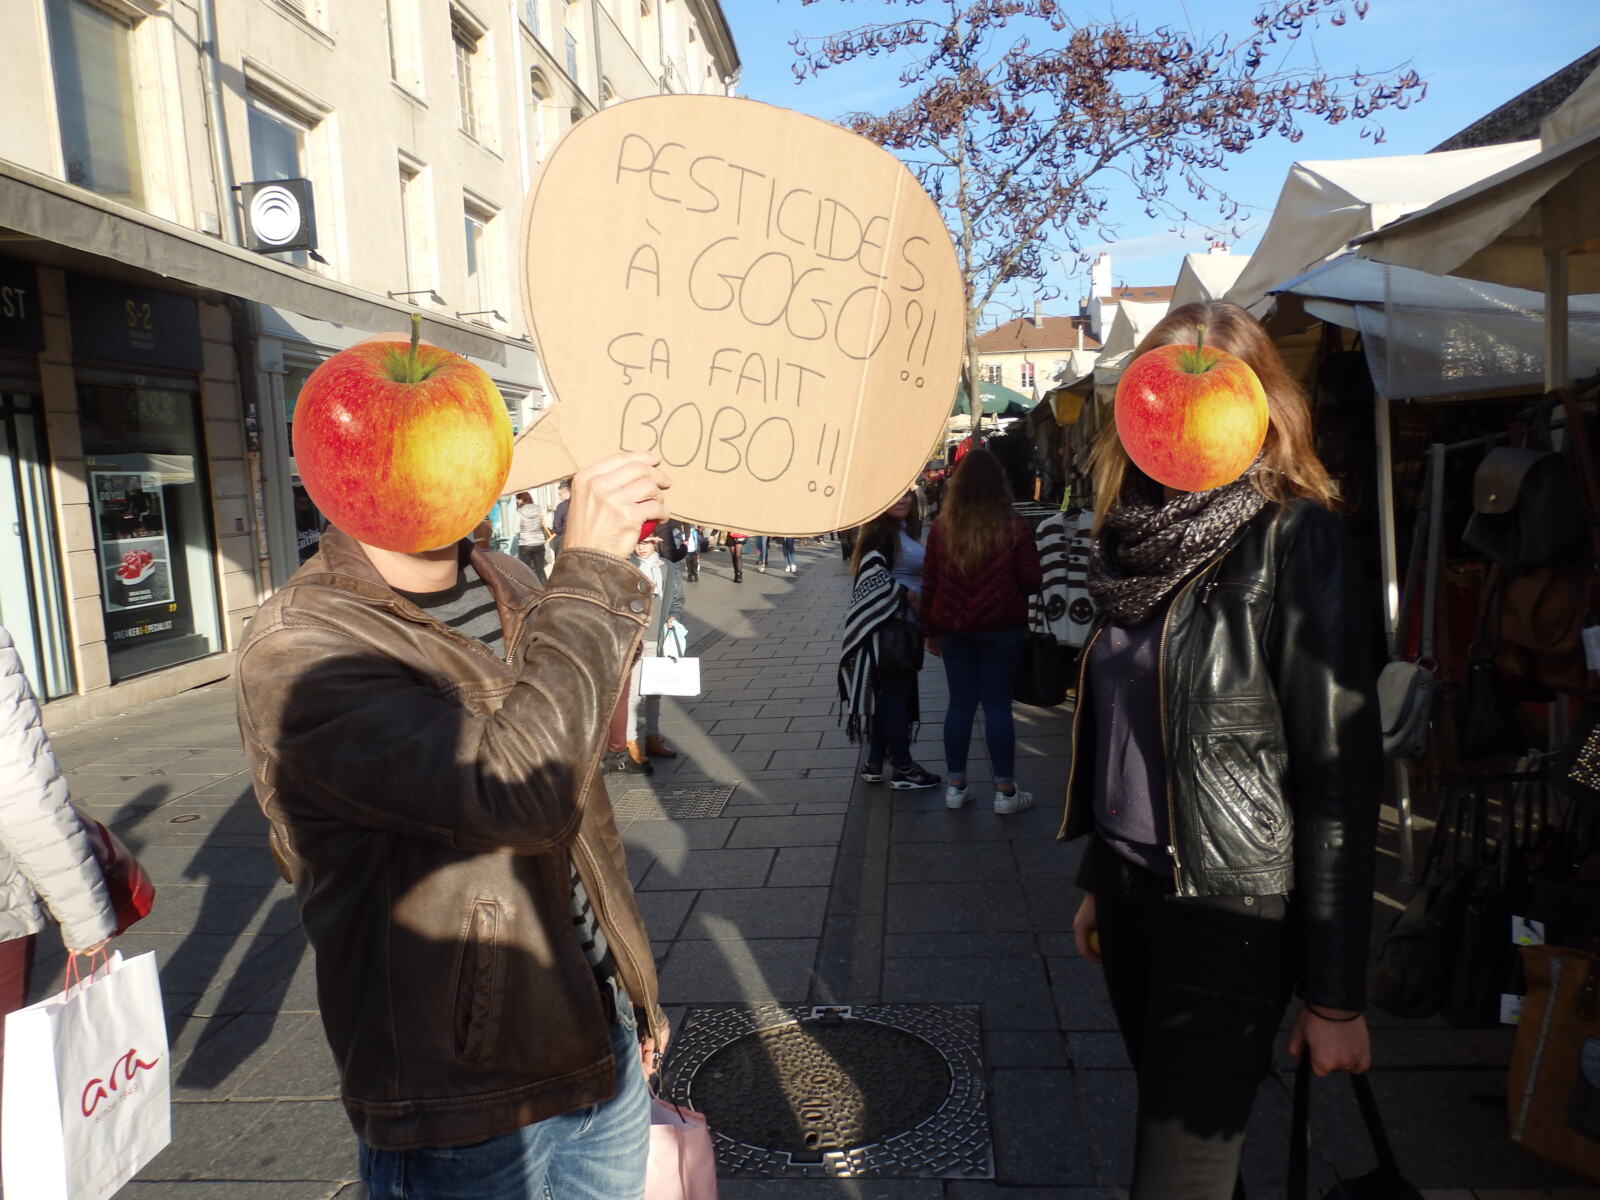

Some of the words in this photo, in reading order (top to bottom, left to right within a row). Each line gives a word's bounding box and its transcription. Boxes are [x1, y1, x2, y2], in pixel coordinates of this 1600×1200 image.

[616, 133, 930, 292] PESTICIDES
[625, 218, 661, 296] À
[607, 332, 671, 385] ÇA
[708, 348, 826, 406] FAIT
[81, 1048, 160, 1117] ara
